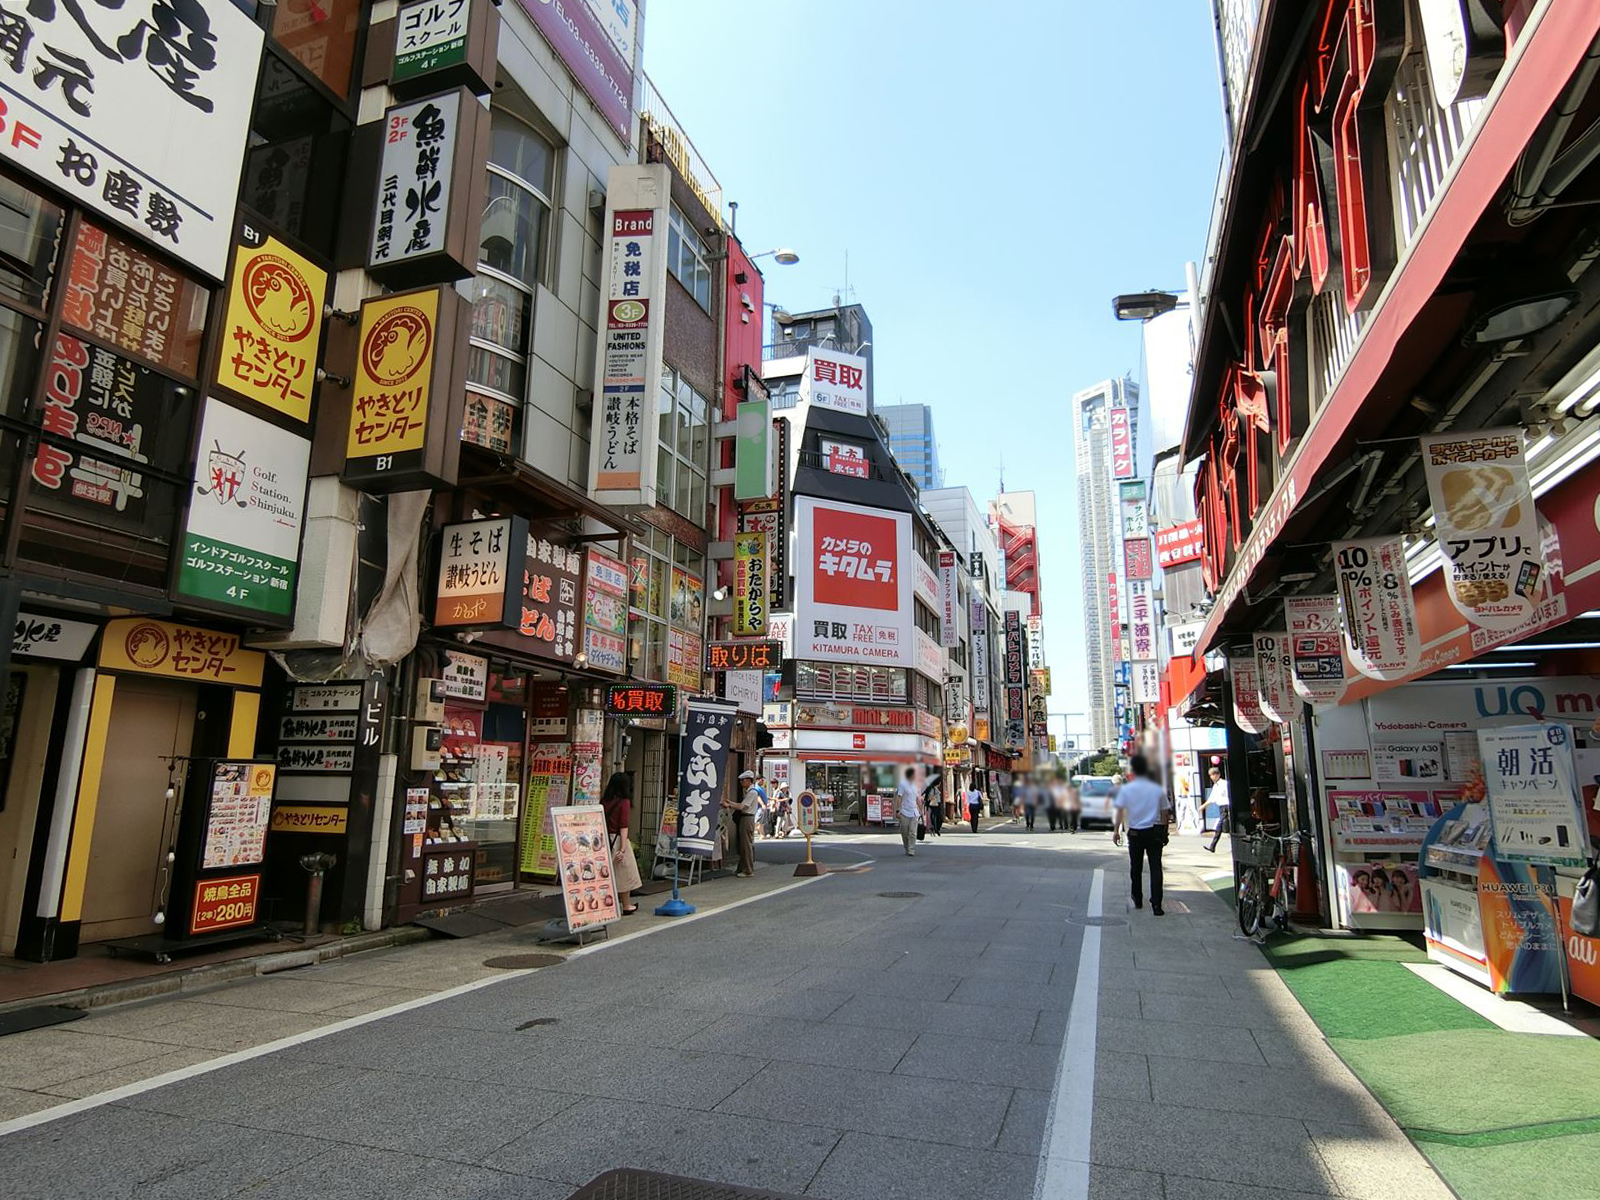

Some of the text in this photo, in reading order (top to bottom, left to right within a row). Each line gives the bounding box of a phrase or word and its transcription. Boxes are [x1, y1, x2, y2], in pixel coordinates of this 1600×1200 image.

[404, 0, 461, 31] ゴルフ
[404, 21, 461, 49] スクール
[398, 46, 450, 64] ゴルフステーション
[391, 116, 408, 129] 3F
[388, 131, 408, 144] 2F
[56, 138, 183, 244] お座敷
[404, 104, 446, 254] 魚鮮水産
[375, 174, 398, 259] 三代目網元
[615, 217, 652, 231] Brand
[244, 225, 260, 244] B1
[622, 241, 641, 296] 免税店
[620, 304, 640, 319] 3F
[607, 342, 646, 351] FASHIONS
[613, 332, 641, 340] UNITED
[232, 326, 307, 379] やきとり
[231, 353, 306, 400] センター
[813, 358, 863, 390] 買取
[356, 387, 423, 418] やきとり
[355, 416, 423, 444] センター
[603, 396, 621, 470] 讃岐うどん
[624, 396, 640, 455] 本格そば
[1112, 413, 1130, 471] カラオケ
[253, 466, 277, 484] Golf.
[376, 456, 393, 471] B1
[251, 481, 292, 504] Station.
[249, 495, 298, 520] Shinjuku.
[450, 526, 503, 558] 生そば
[821, 536, 872, 555] カメラの
[1447, 536, 1532, 561] アプリで
[190, 541, 289, 576] インドアゴルフスクール
[819, 553, 893, 583] キタムラ
[1453, 560, 1510, 573] ポイントが
[186, 556, 288, 591] ゴルフステーション 新宿
[446, 561, 500, 590] 讃岐うどん
[748, 557, 763, 631] おたからや
[1474, 604, 1523, 613] ヨドバシカメラ
[813, 620, 847, 640] 買取
[853, 623, 873, 633] TAX
[853, 633, 874, 644] FREE
[878, 630, 896, 641] 免税
[173, 628, 236, 658] やきとり
[812, 643, 900, 658] KITAMURA CAMERA
[171, 651, 236, 678] センター
[710, 646, 771, 668] 取りは
[1475, 685, 1600, 721] UQ m
[1375, 720, 1467, 731] Yodobashi-Camera
[1388, 744, 1439, 754] Galaxy A30
[1498, 746, 1554, 777] 朝活
[1499, 779, 1558, 791] キャンペーン
[285, 813, 346, 827] やきとりセンター
[203, 882, 252, 903] 焼鳥全品
[1481, 882, 1532, 895] HUAWEI
[216, 901, 252, 922] 280円
[1569, 935, 1598, 966] au
